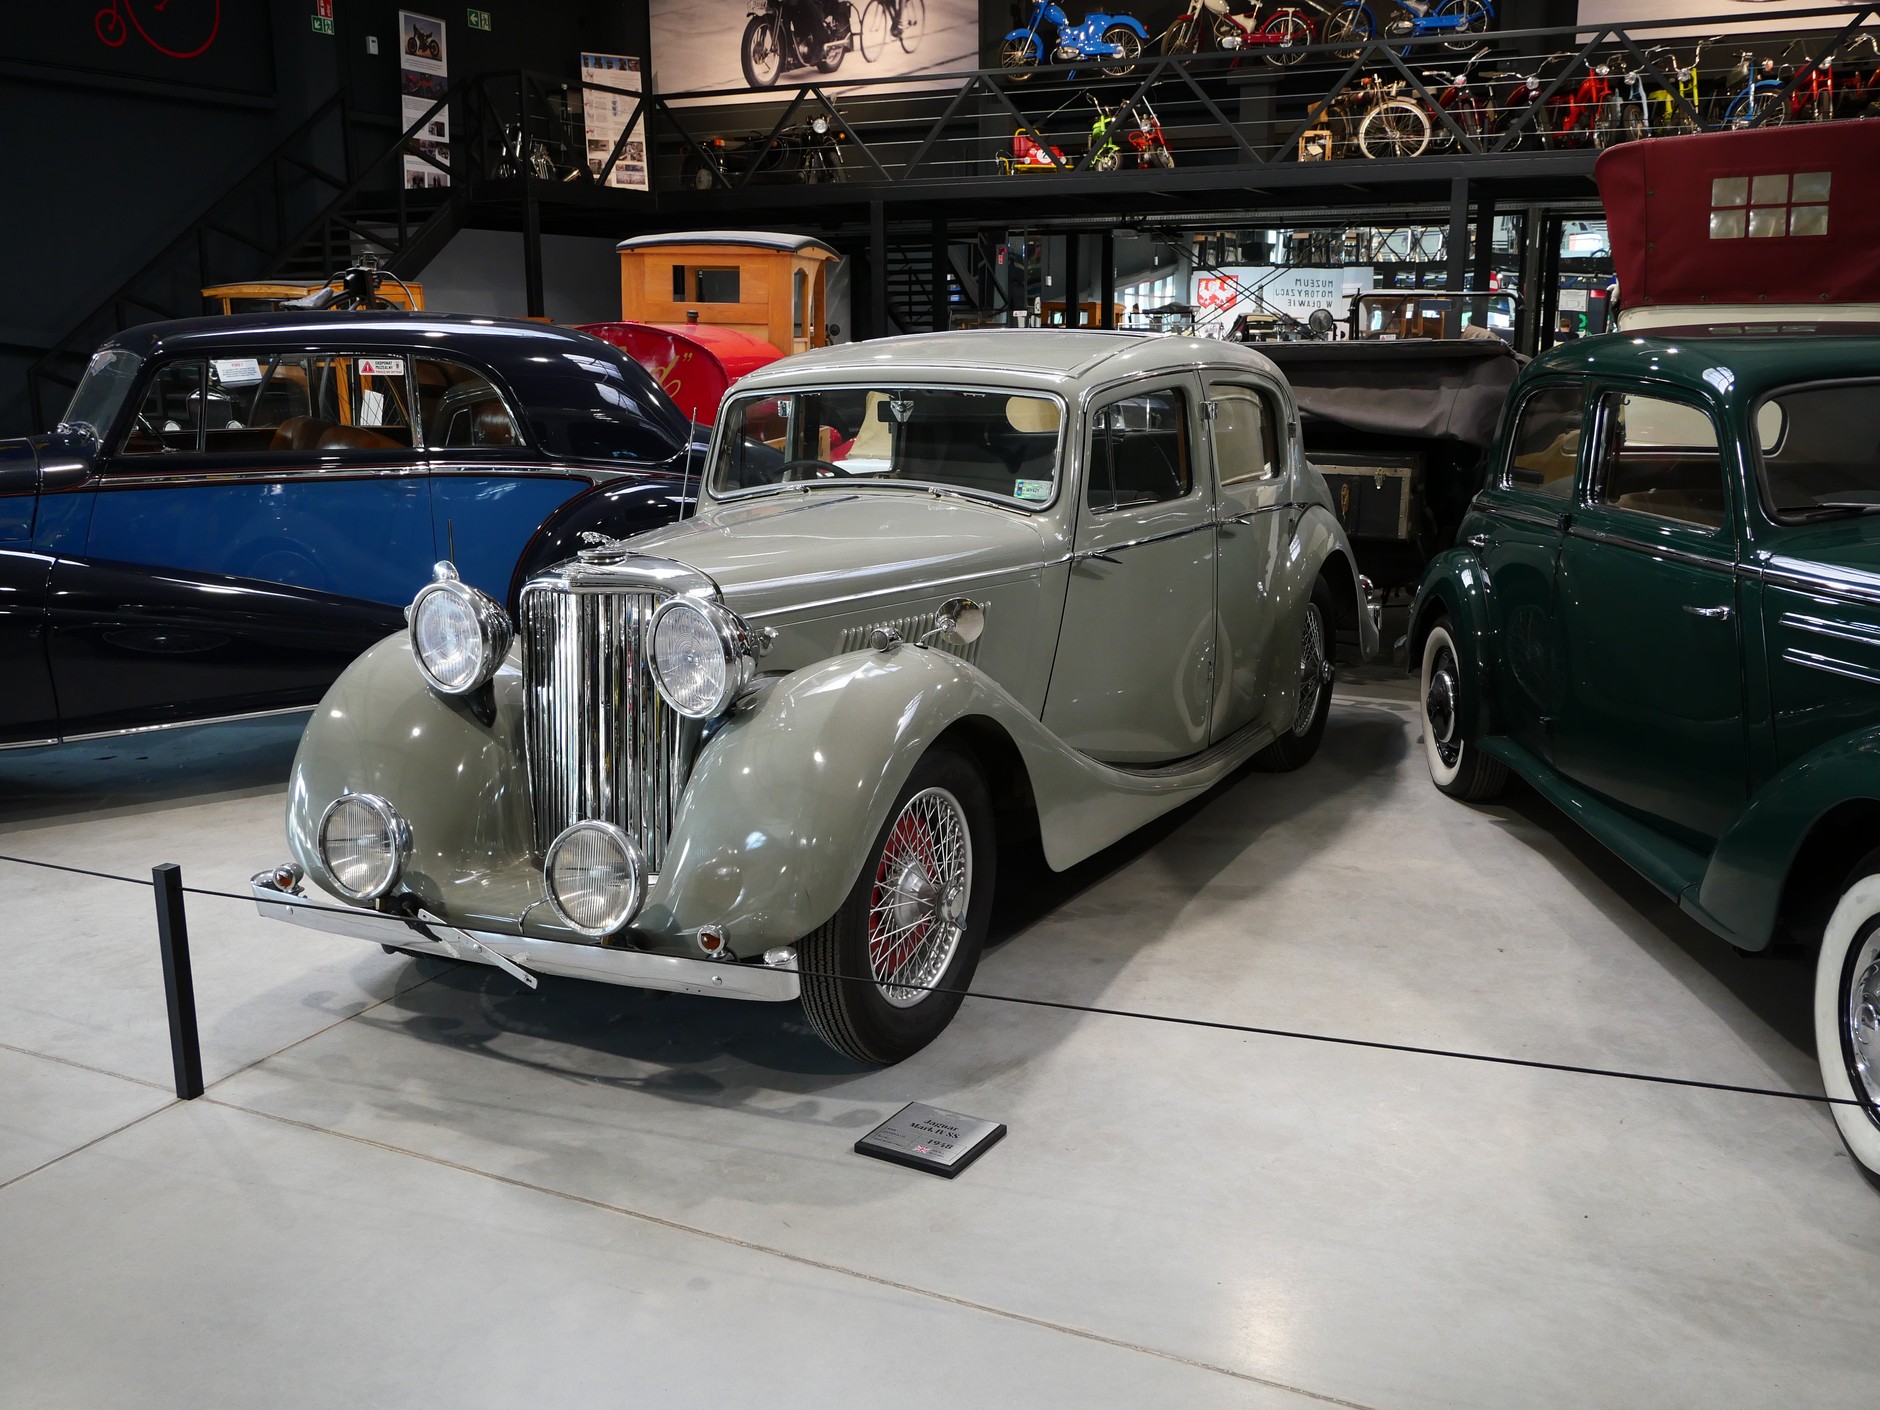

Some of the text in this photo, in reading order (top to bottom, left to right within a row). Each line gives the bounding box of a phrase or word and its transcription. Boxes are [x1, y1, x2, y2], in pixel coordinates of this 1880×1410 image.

[909, 1122, 934, 1133] Mark
[946, 1130, 960, 1140] SS
[924, 1119, 959, 1131] Jaguar
[927, 1139, 954, 1150] 1948
